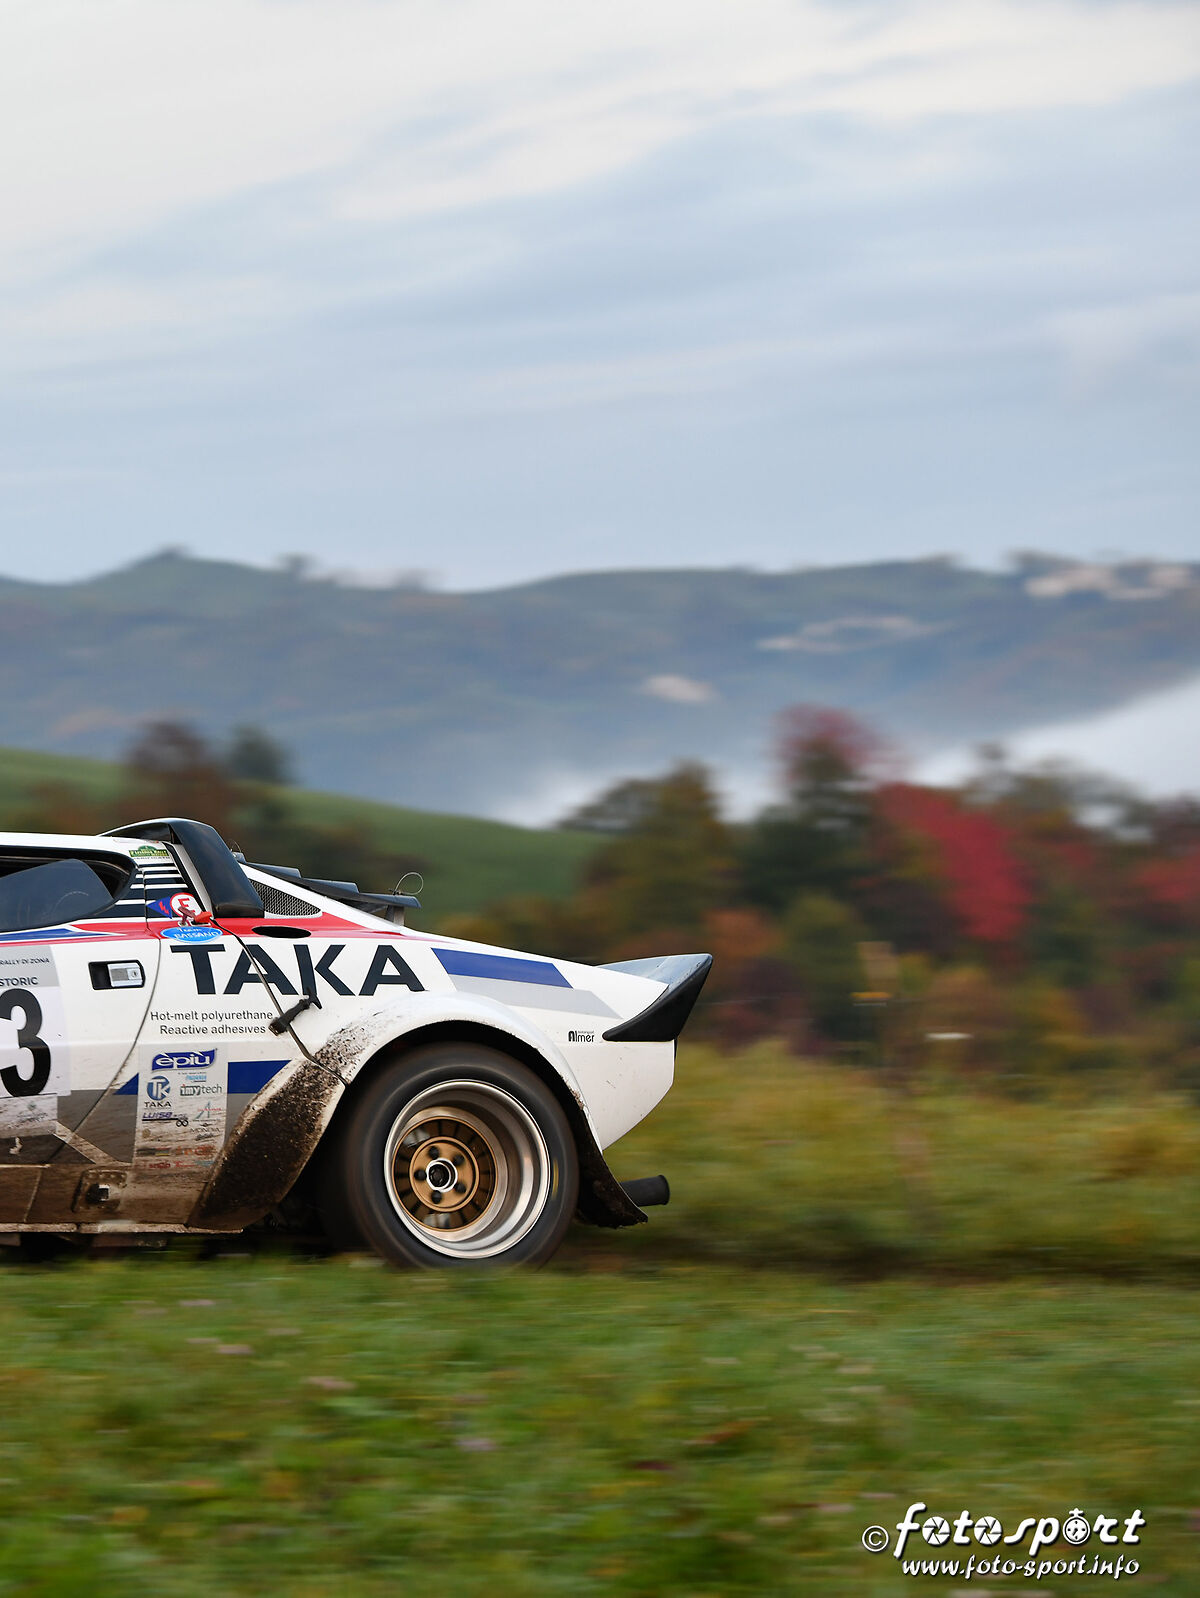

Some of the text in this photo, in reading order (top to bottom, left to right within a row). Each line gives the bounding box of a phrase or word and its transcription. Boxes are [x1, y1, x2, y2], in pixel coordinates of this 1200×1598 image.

[170, 944, 426, 996] TAKA
[150, 1010, 273, 1022] Hot-melt polyurethane
[160, 1024, 266, 1035] Reactive adhesives
[568, 1030, 595, 1042] Almer
[147, 1077, 171, 1100] TK
